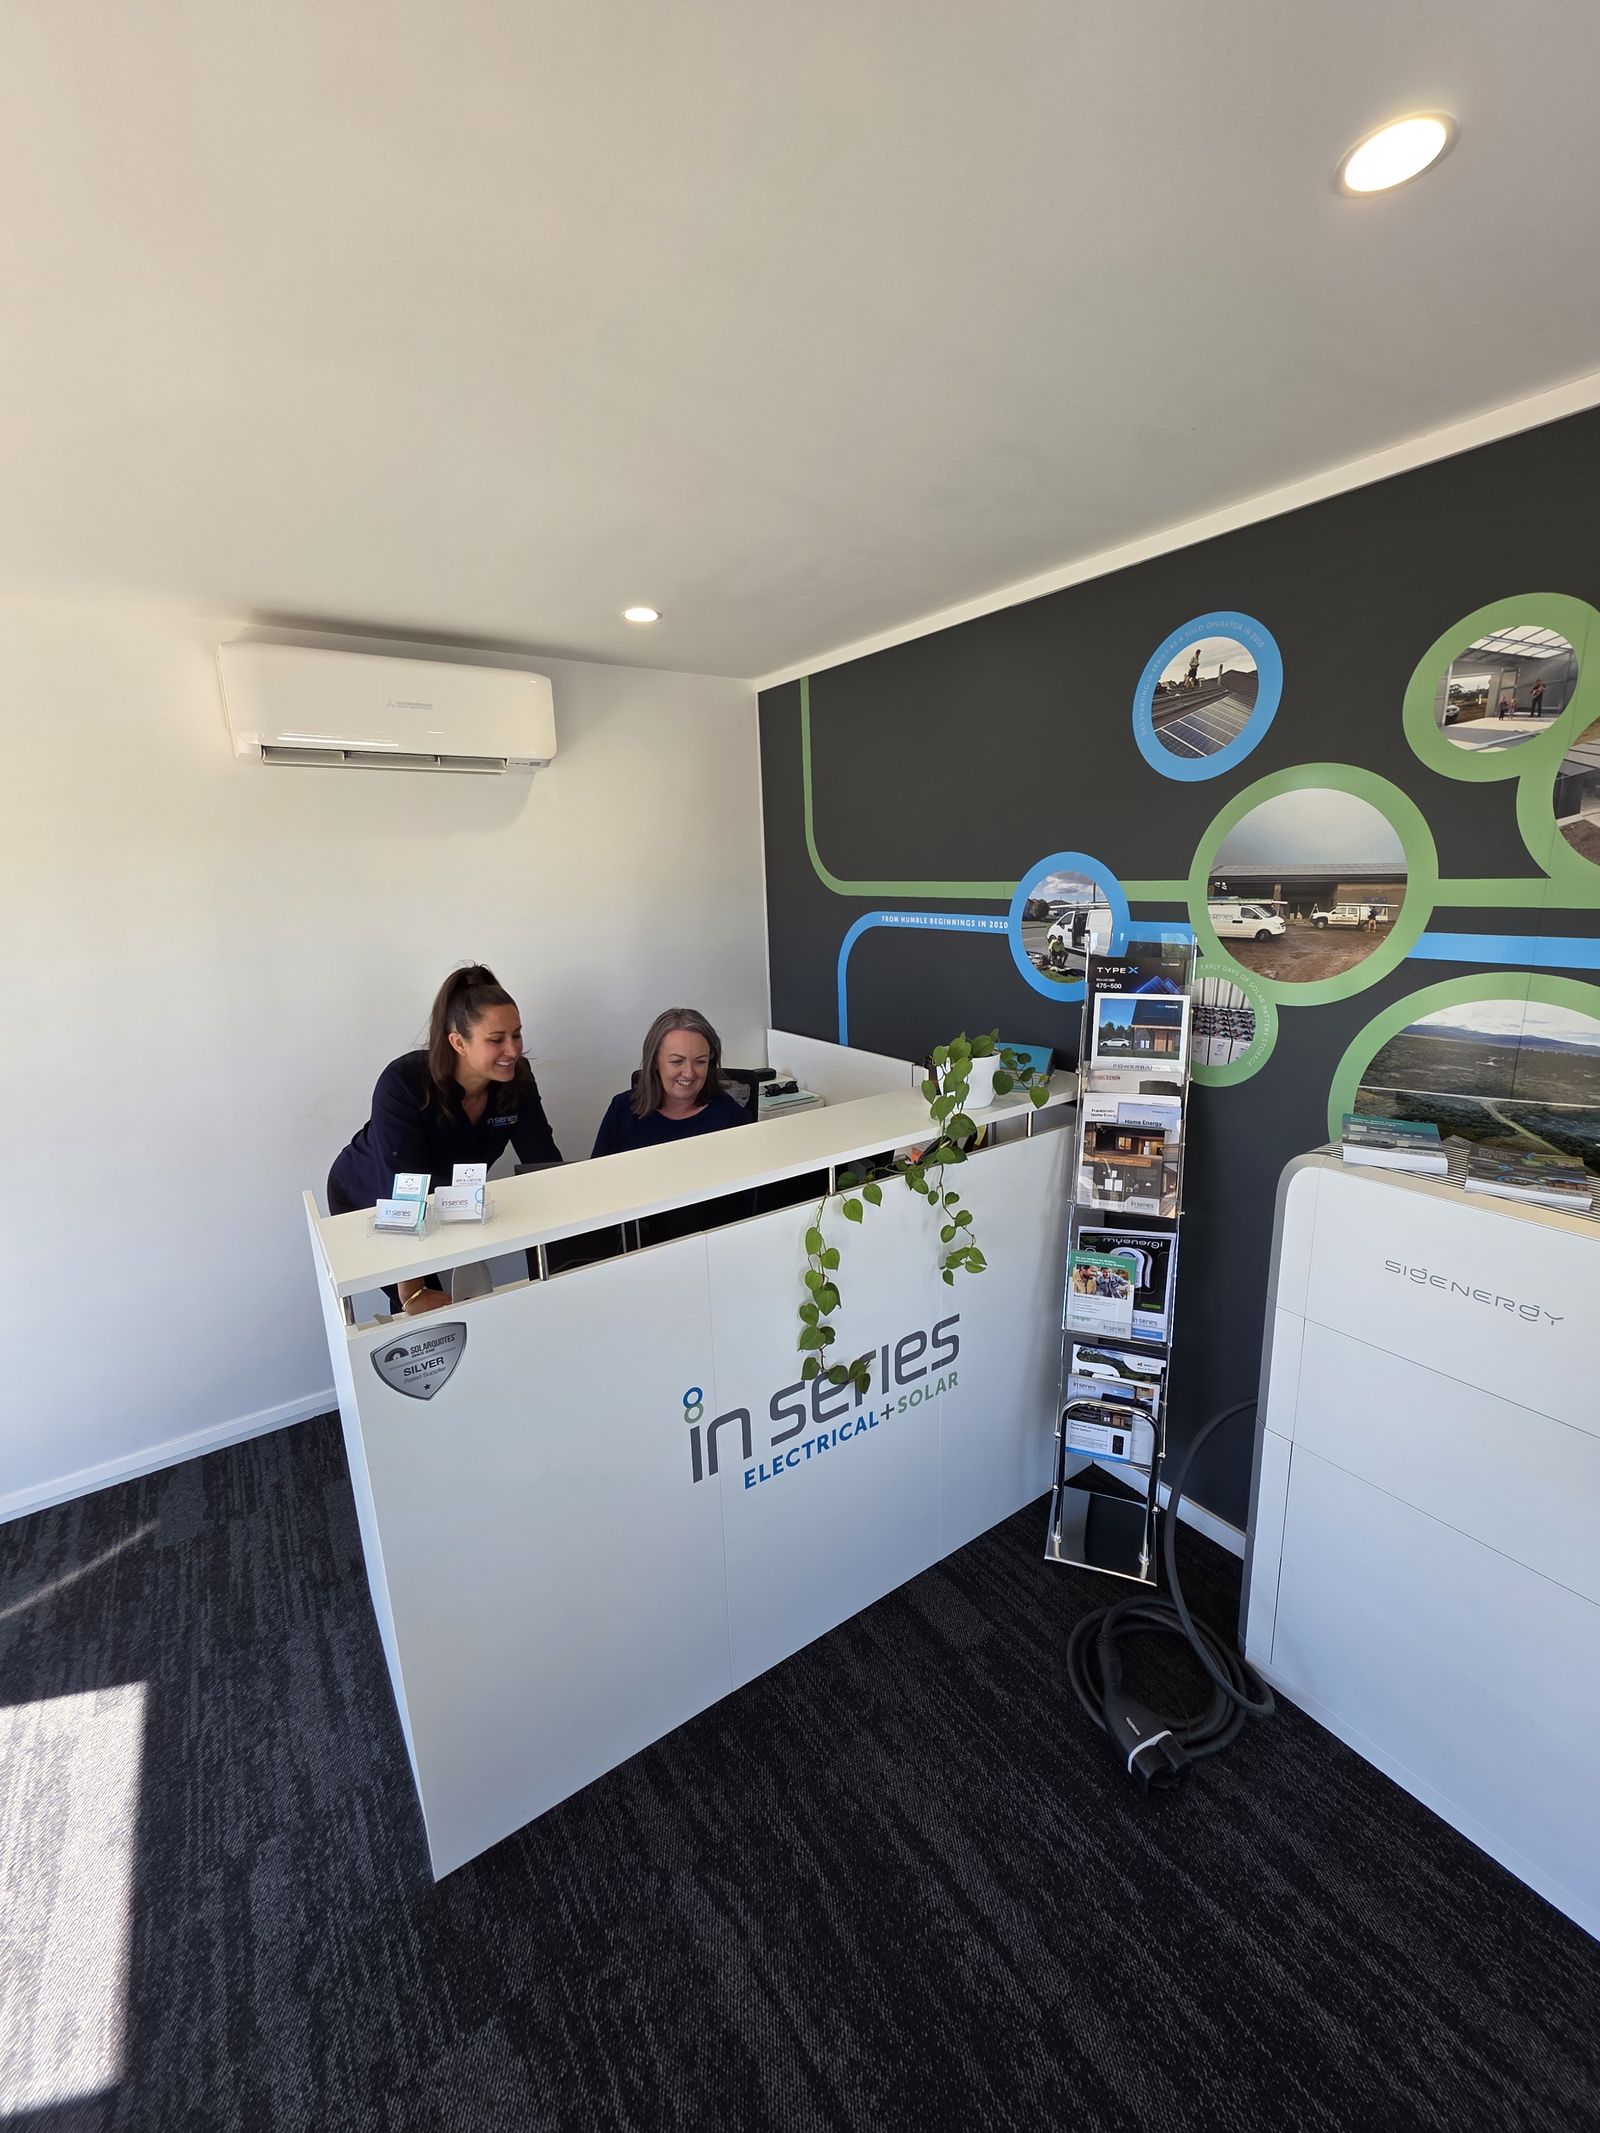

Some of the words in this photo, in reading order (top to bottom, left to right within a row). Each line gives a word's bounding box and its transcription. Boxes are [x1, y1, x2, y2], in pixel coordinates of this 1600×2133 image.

[1205, 620, 1243, 631] OPERATOR
[881, 915, 899, 923] FROM
[900, 916, 928, 924] HUMBLE
[929, 917, 976, 927] BEGINNINGS
[977, 920, 987, 928] IN
[989, 920, 1009, 929] 2010
[1222, 965, 1239, 977] DAYS
[1241, 974, 1249, 983] OF
[1248, 982, 1265, 1003] SOLAR
[1261, 1005, 1271, 1036] BATTERY
[1247, 1038, 1269, 1067] STORAGE
[1142, 1120, 1163, 1128] Energy
[1103, 1236, 1164, 1249] myenergi
[410, 1334, 455, 1355] SOLARQUOTES
[403, 1356, 445, 1377] SILVER
